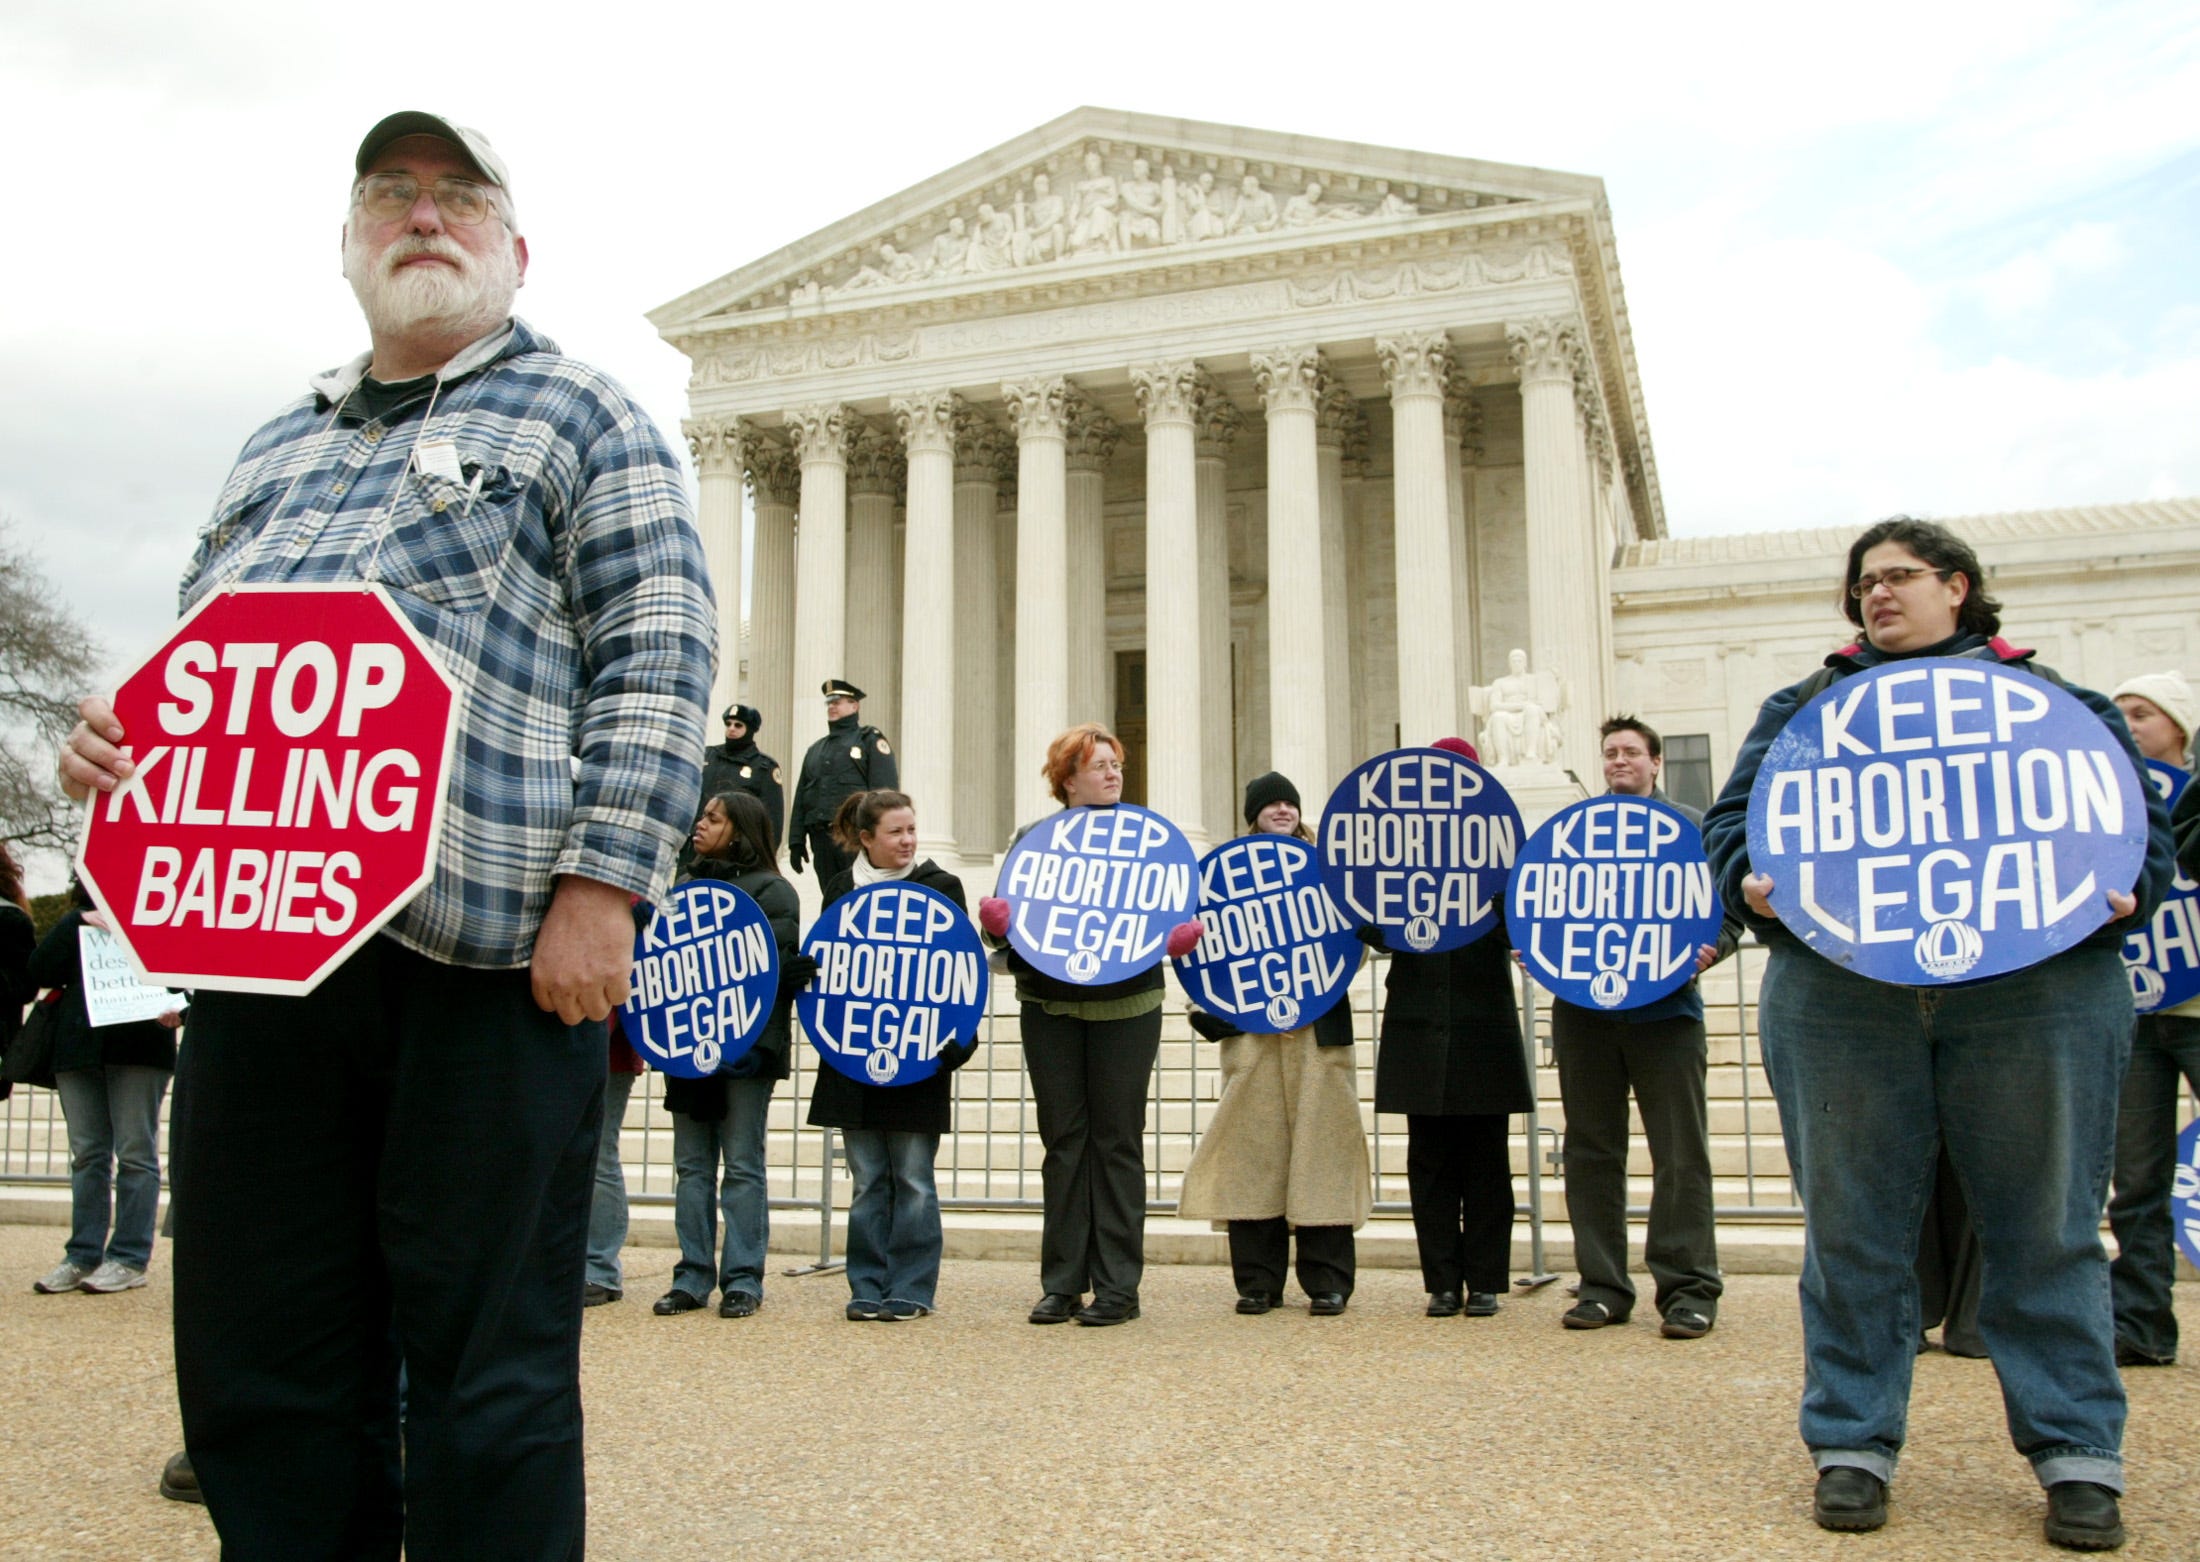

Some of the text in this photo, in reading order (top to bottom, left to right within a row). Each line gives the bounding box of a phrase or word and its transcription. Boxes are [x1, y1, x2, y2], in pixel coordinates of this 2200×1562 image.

[157, 640, 406, 737] STOP
[1821, 668, 2049, 759] KEEP
[105, 745, 421, 832] KILLING
[1359, 755, 1483, 809] KEEP
[1766, 749, 2124, 855] ABORTION
[1051, 809, 1169, 858] KEEP
[1327, 813, 1515, 869] ABORTION
[1552, 803, 1681, 858] KEEP
[131, 845, 361, 936] BABIES
[1008, 850, 1190, 913] ABORTION
[1199, 841, 1307, 907] KEEP
[1344, 871, 1493, 927] LEGAL
[1516, 862, 1712, 920] ABORTION
[1800, 840, 2095, 945] LEGAL
[643, 886, 736, 953] KEEP
[838, 887, 954, 944] KEEP
[1016, 902, 1164, 963] LEGAL
[1914, 920, 1983, 963] NOW
[625, 922, 769, 1014] ABORTION
[804, 940, 978, 1007] ABORTION
[1200, 941, 1346, 1014] LEGAL
[1532, 922, 1692, 982] LEGAL
[641, 985, 761, 1059] LEGAL
[815, 1000, 956, 1061] LEGAL
